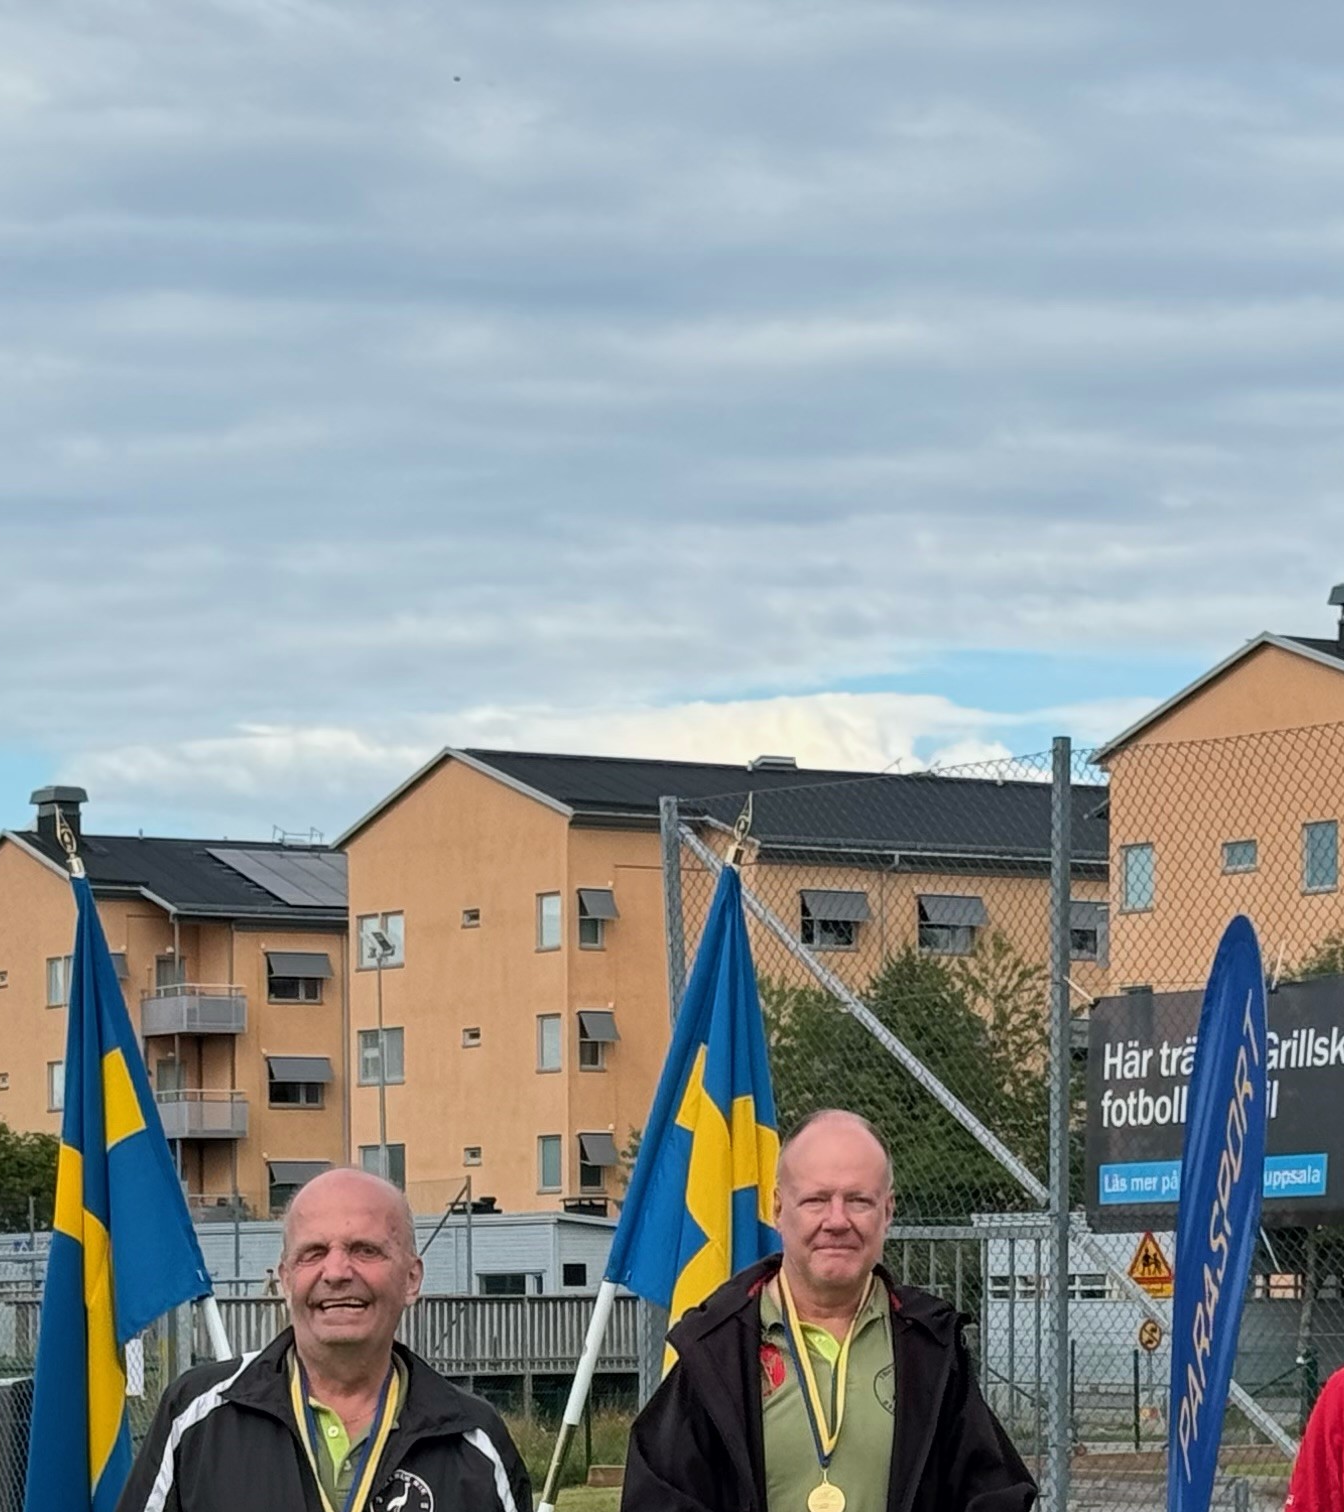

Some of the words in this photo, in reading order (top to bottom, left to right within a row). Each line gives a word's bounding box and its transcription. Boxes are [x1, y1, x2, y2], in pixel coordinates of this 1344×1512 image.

[1103, 1040, 1153, 1081] Här
[1160, 1035, 1199, 1077] trä
[1101, 1085, 1189, 1128] fotboll
[1131, 1176, 1158, 1192] mer
[1177, 988, 1259, 1483] PARASPORT
